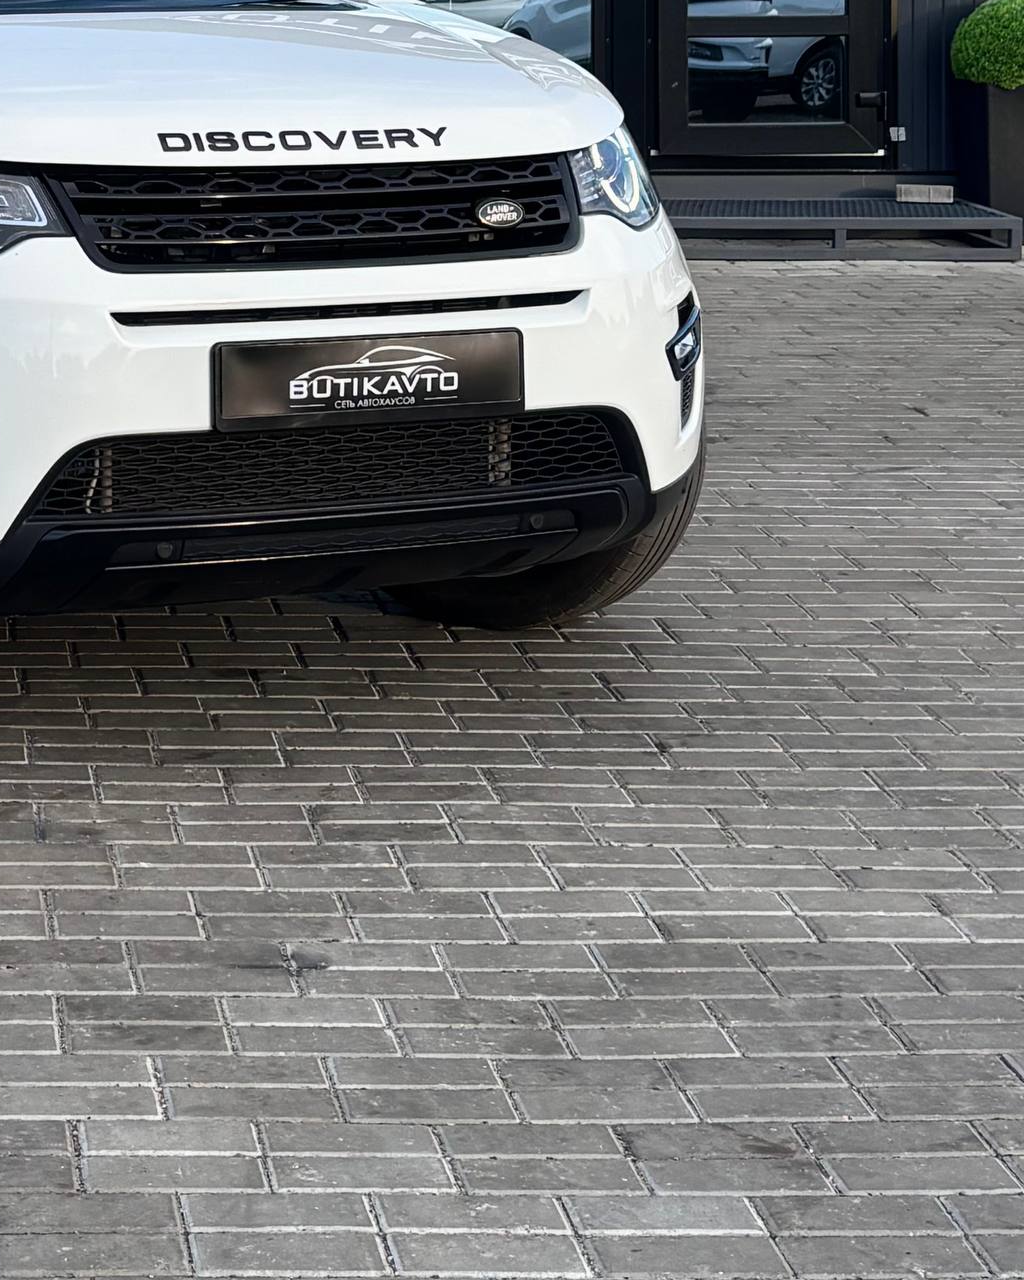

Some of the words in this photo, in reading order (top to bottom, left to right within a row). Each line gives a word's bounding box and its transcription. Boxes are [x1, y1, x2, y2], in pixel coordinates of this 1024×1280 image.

[157, 126, 448, 153] DISCOVERY
[486, 204, 510, 214] LAND
[490, 211, 518, 223] ROVER
[289, 372, 459, 400] BUTIKAVTO
[334, 399, 355, 410] СЕТЬ
[357, 396, 416, 408] АВТОХАУСОВ
